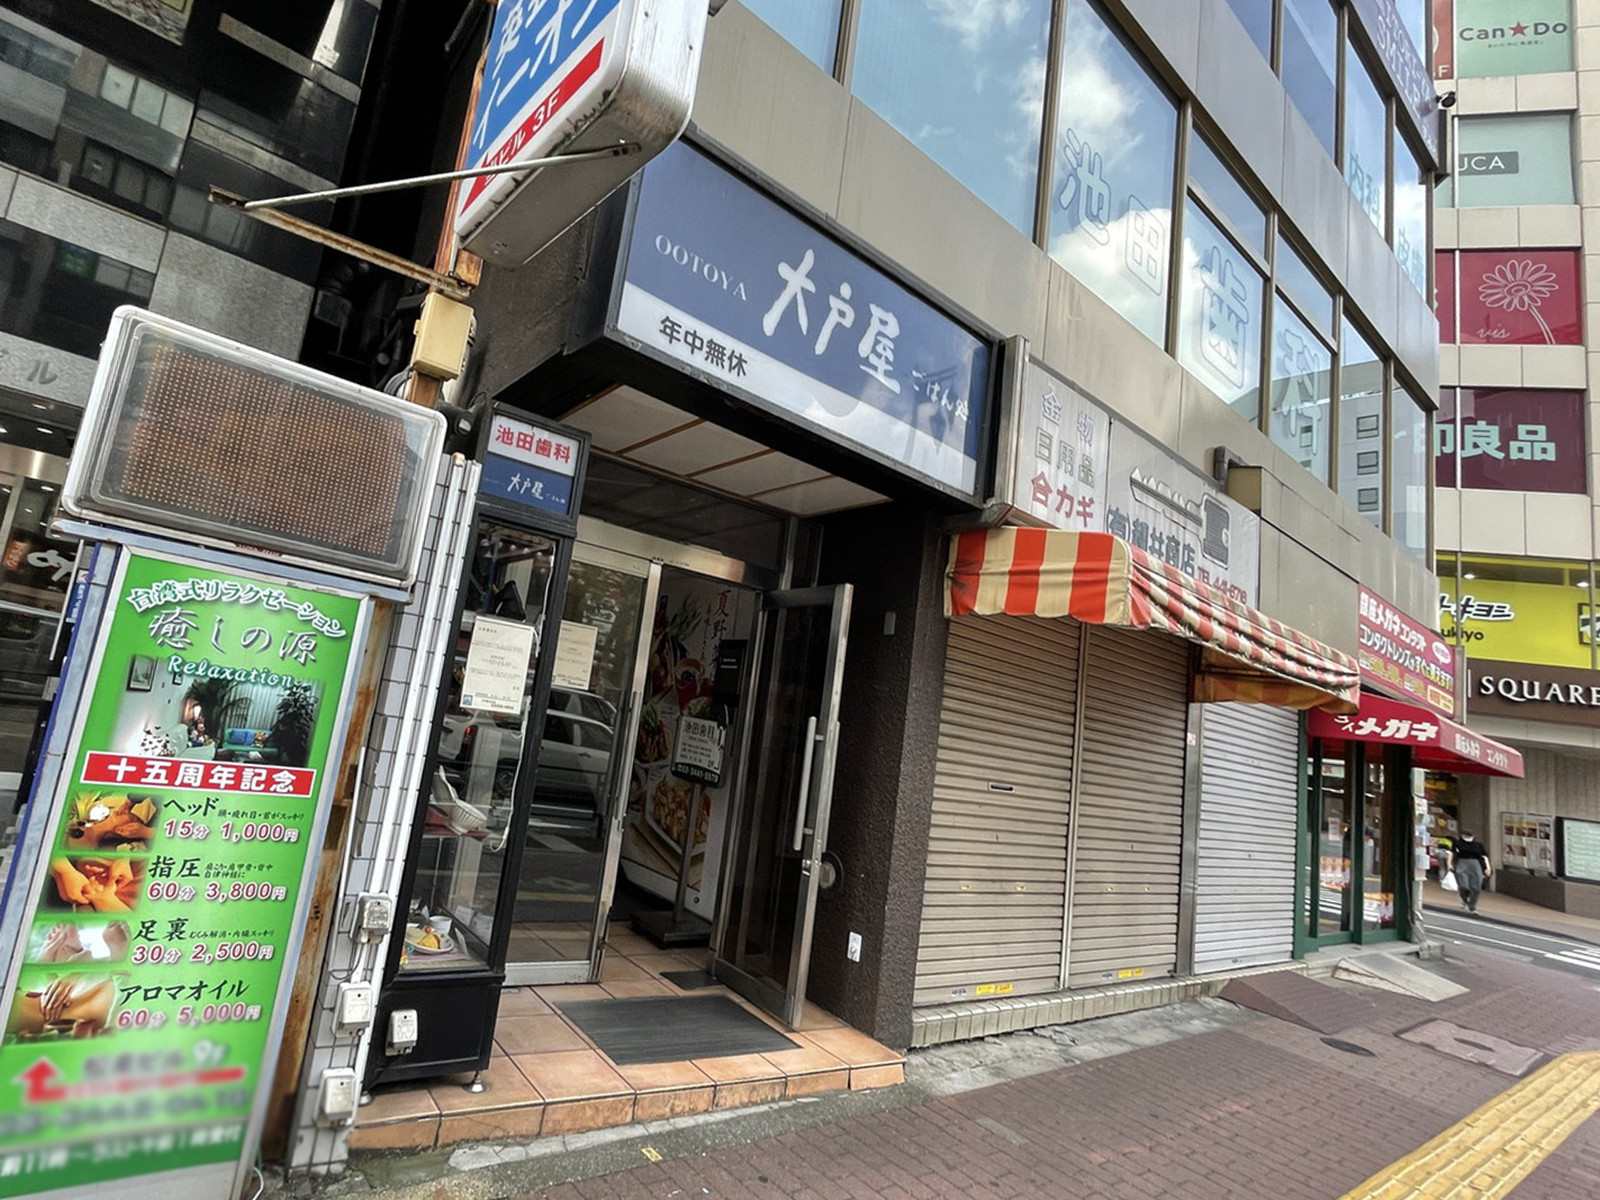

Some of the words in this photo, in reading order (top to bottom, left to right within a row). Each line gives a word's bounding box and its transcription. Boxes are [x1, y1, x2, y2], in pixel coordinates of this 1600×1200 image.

[532, 88, 560, 132] 3F
[654, 233, 748, 302] OOTOYA
[1058, 127, 1323, 457] 池田歯科
[763, 248, 902, 395] 大戸屋
[658, 315, 749, 378] 年中無休
[1041, 387, 1096, 448] 金物
[495, 424, 571, 463] 池田歯科
[1035, 425, 1096, 489] 日用品
[506, 472, 545, 501] 大戸屋
[1030, 470, 1096, 529] 合カギ
[126, 577, 347, 639] 台湾式リラクゼーション
[148, 606, 318, 668] 癒しの源
[166, 654, 296, 691] Relaxation
[1480, 675, 1600, 706] SQUARE
[1355, 716, 1439, 742] メガネ
[107, 757, 297, 793] 十五周年記念
[162, 796, 219, 818] ヘッド
[163, 819, 210, 840] 15分
[220, 821, 299, 844] 1,000円
[148, 856, 201, 879] 指圧
[146, 881, 196, 901] 60分
[204, 881, 287, 903] 3,800円
[132, 917, 190, 942] 足裏
[131, 944, 182, 964] 30分
[190, 942, 275, 965] 2,500円
[118, 979, 250, 1007] アロマオイル
[116, 1007, 167, 1030] 60分
[176, 1001, 263, 1027] 5,000円
